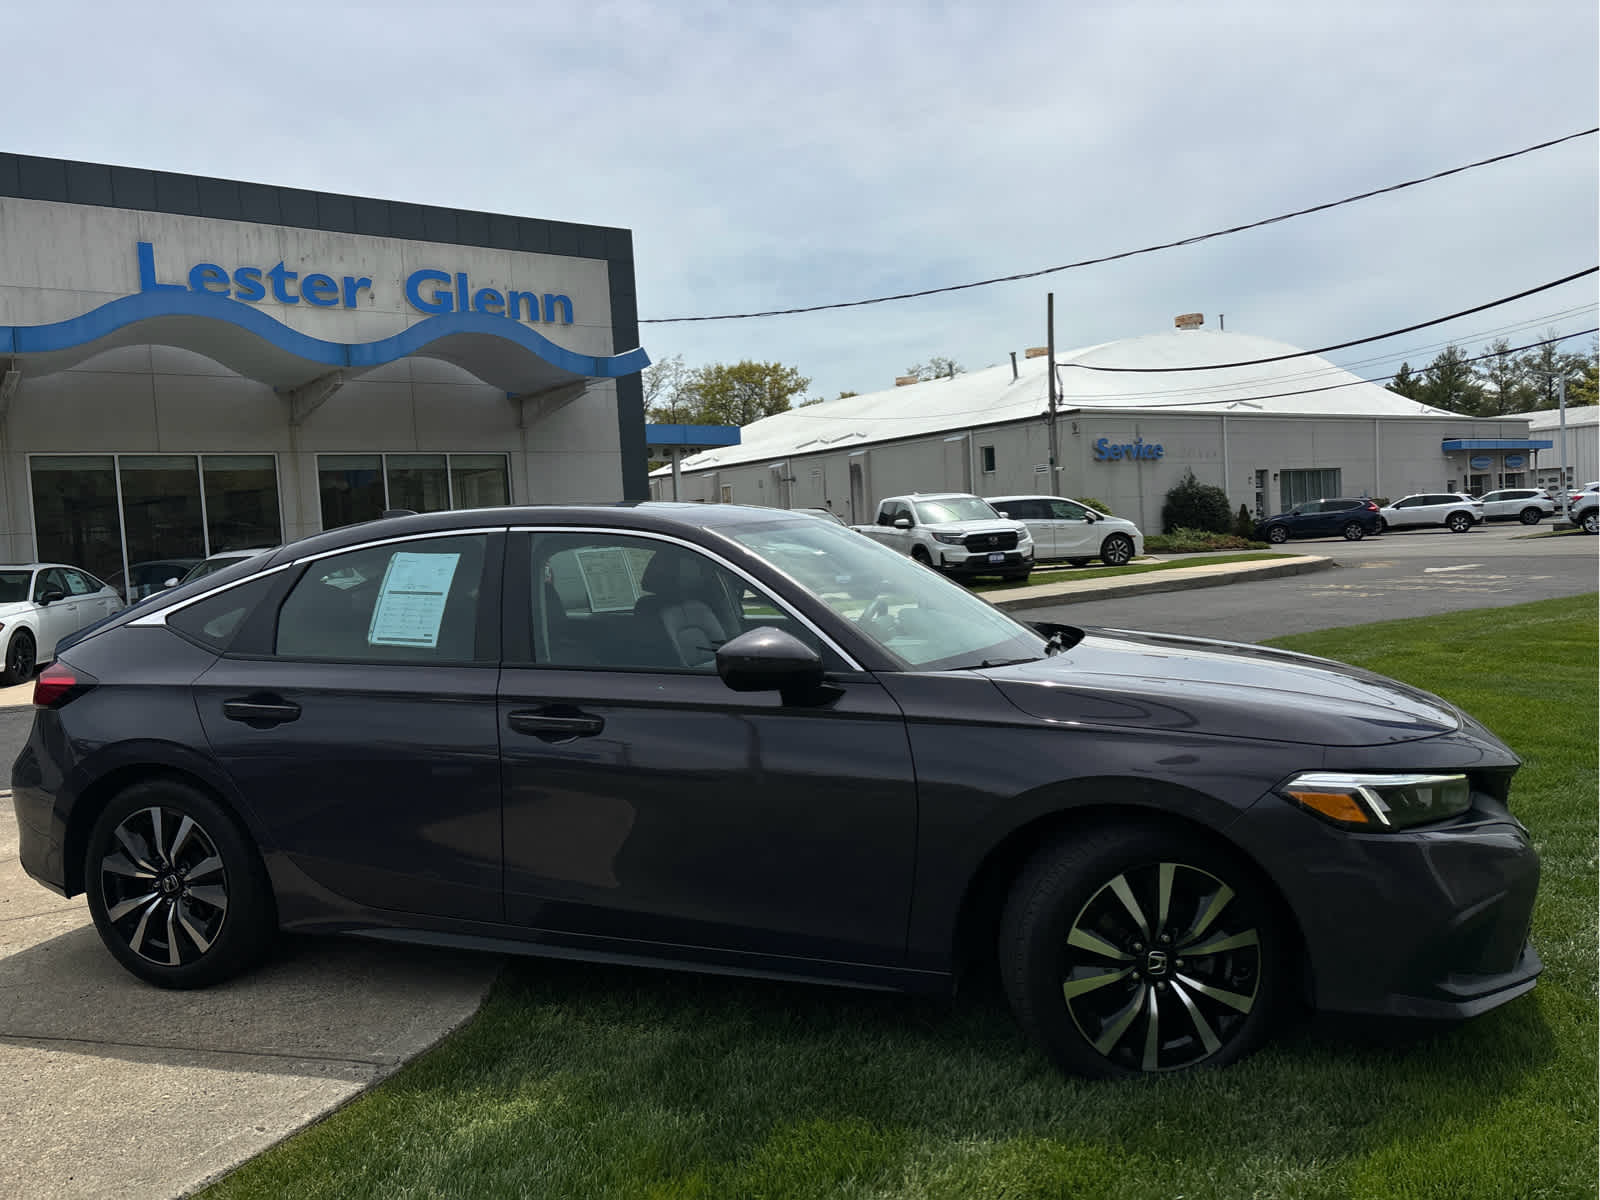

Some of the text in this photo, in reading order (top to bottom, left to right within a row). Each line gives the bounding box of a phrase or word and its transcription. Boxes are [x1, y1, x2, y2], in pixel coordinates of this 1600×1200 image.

[136, 242, 573, 325] Lester Glenn
[1096, 438, 1164, 460] Service
